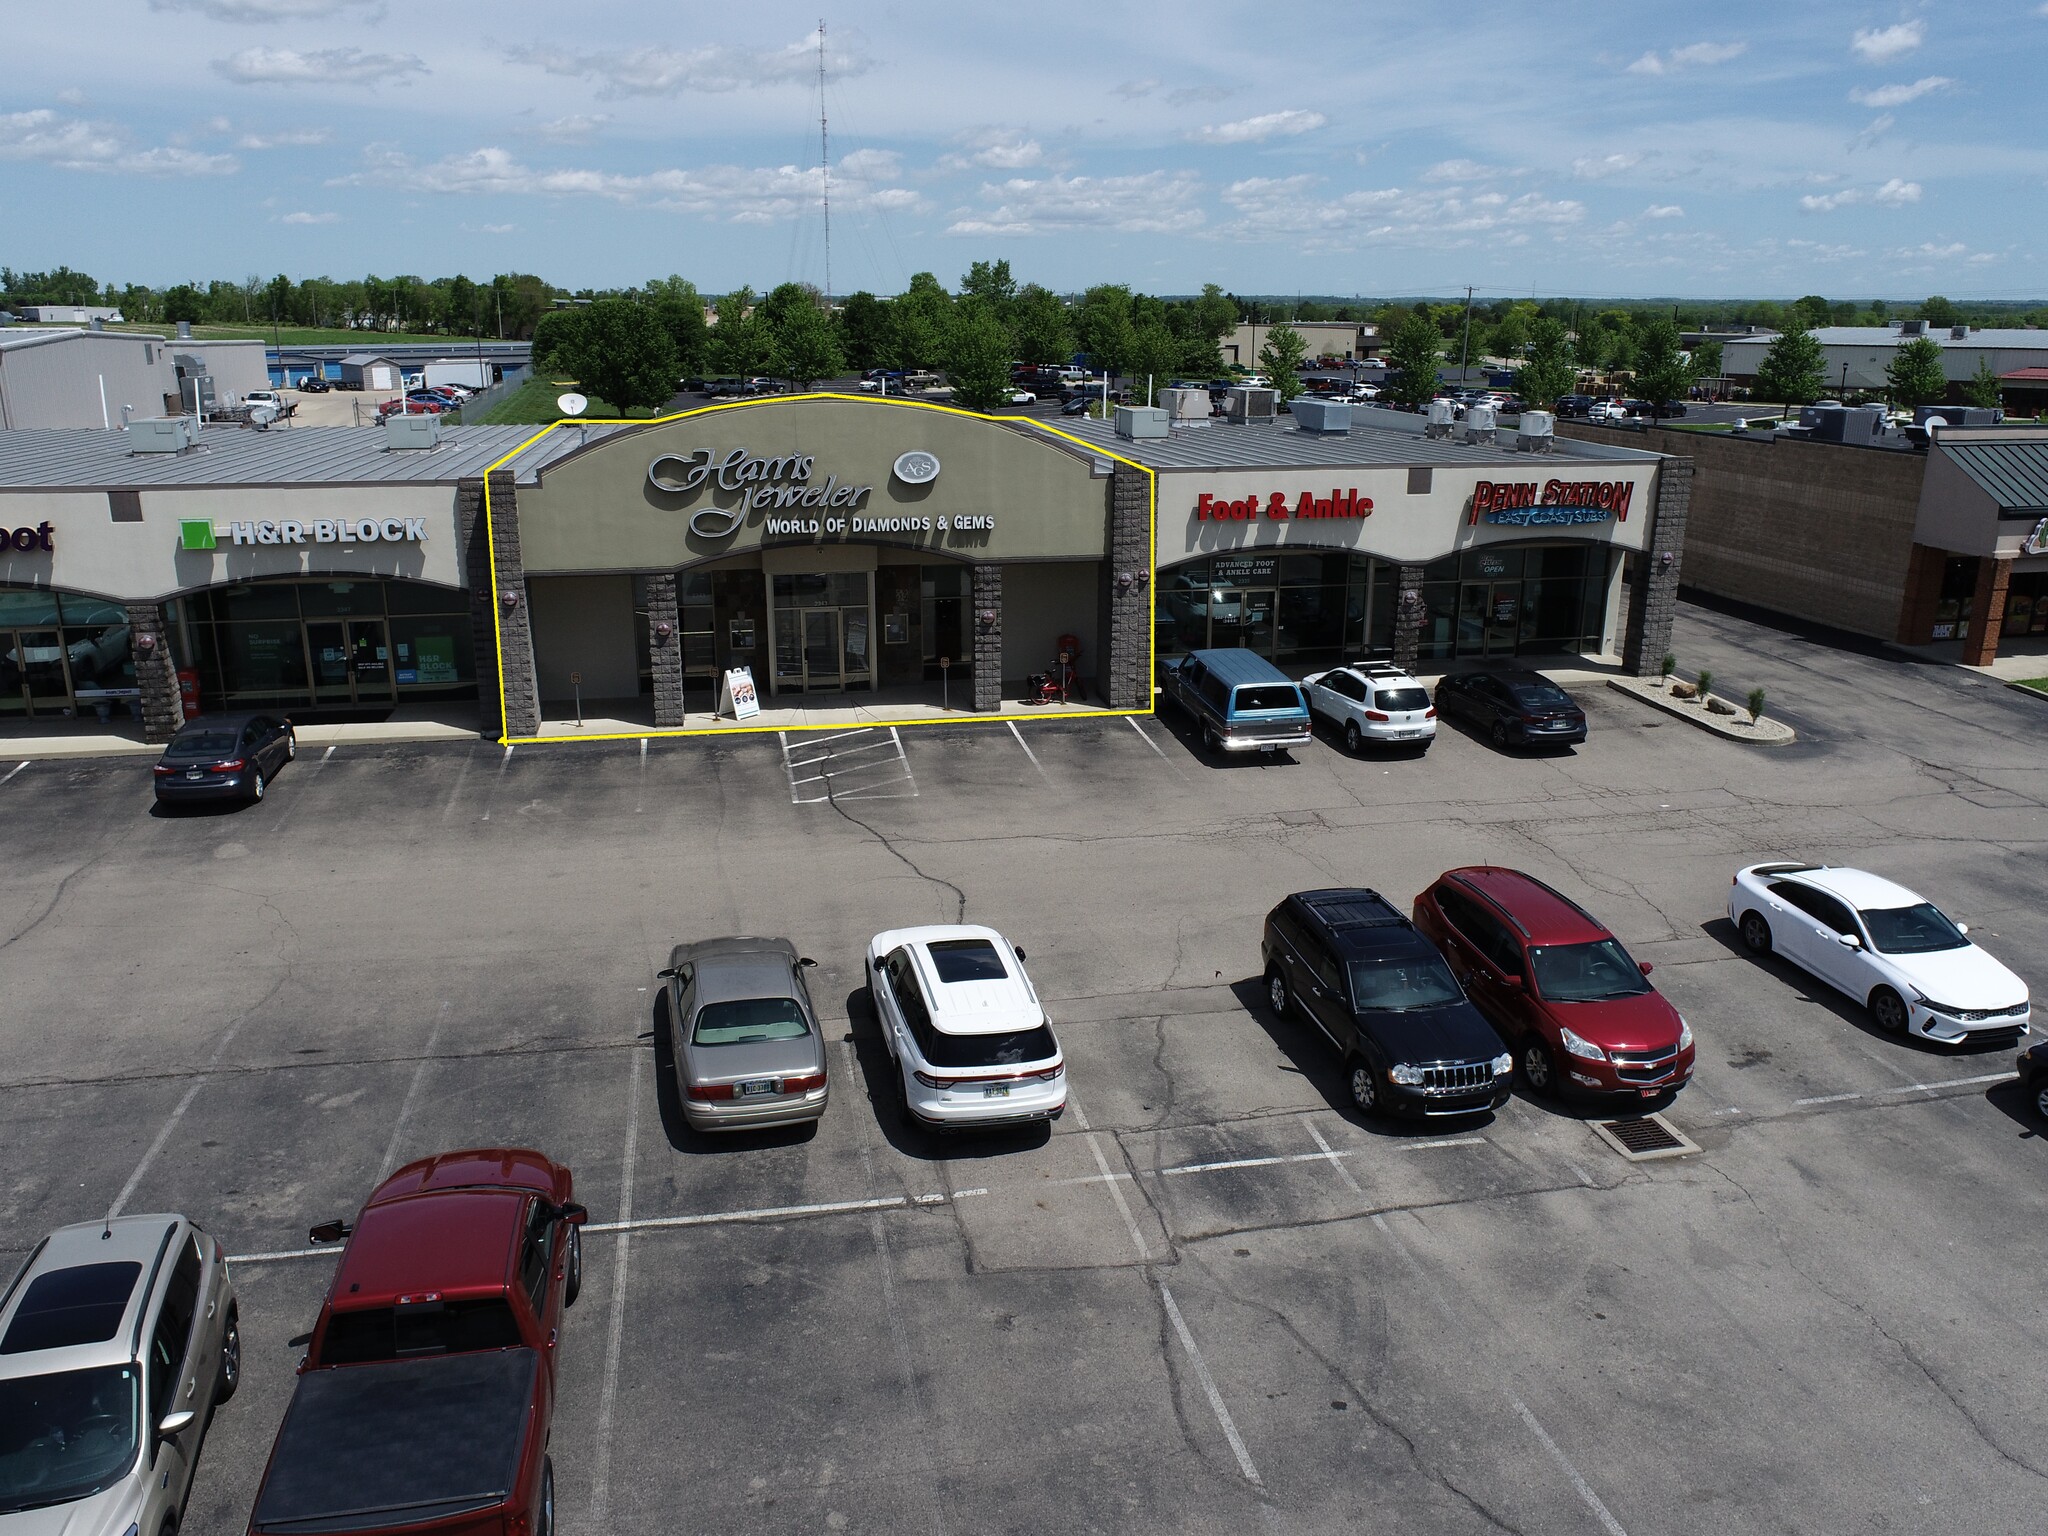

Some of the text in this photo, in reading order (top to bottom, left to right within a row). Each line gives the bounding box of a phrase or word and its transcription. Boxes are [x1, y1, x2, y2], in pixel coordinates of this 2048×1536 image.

[648, 447, 815, 492] Harris
[905, 461, 931, 477] AGS
[1198, 488, 1374, 521] Foot & Ankle
[1468, 478, 1634, 526] PENN STATION
[766, 514, 995, 534] WORLD OF DIAMONDS & GEMS
[1497, 509, 1608, 526] EAST COAST SUBS
[230, 517, 430, 546] H&R BLOCK
[1215, 561, 1254, 569] ADVANCED
[1226, 568, 1250, 576] ANKLE
[419, 654, 440, 663] H&R
[420, 662, 453, 670] BLOCK
